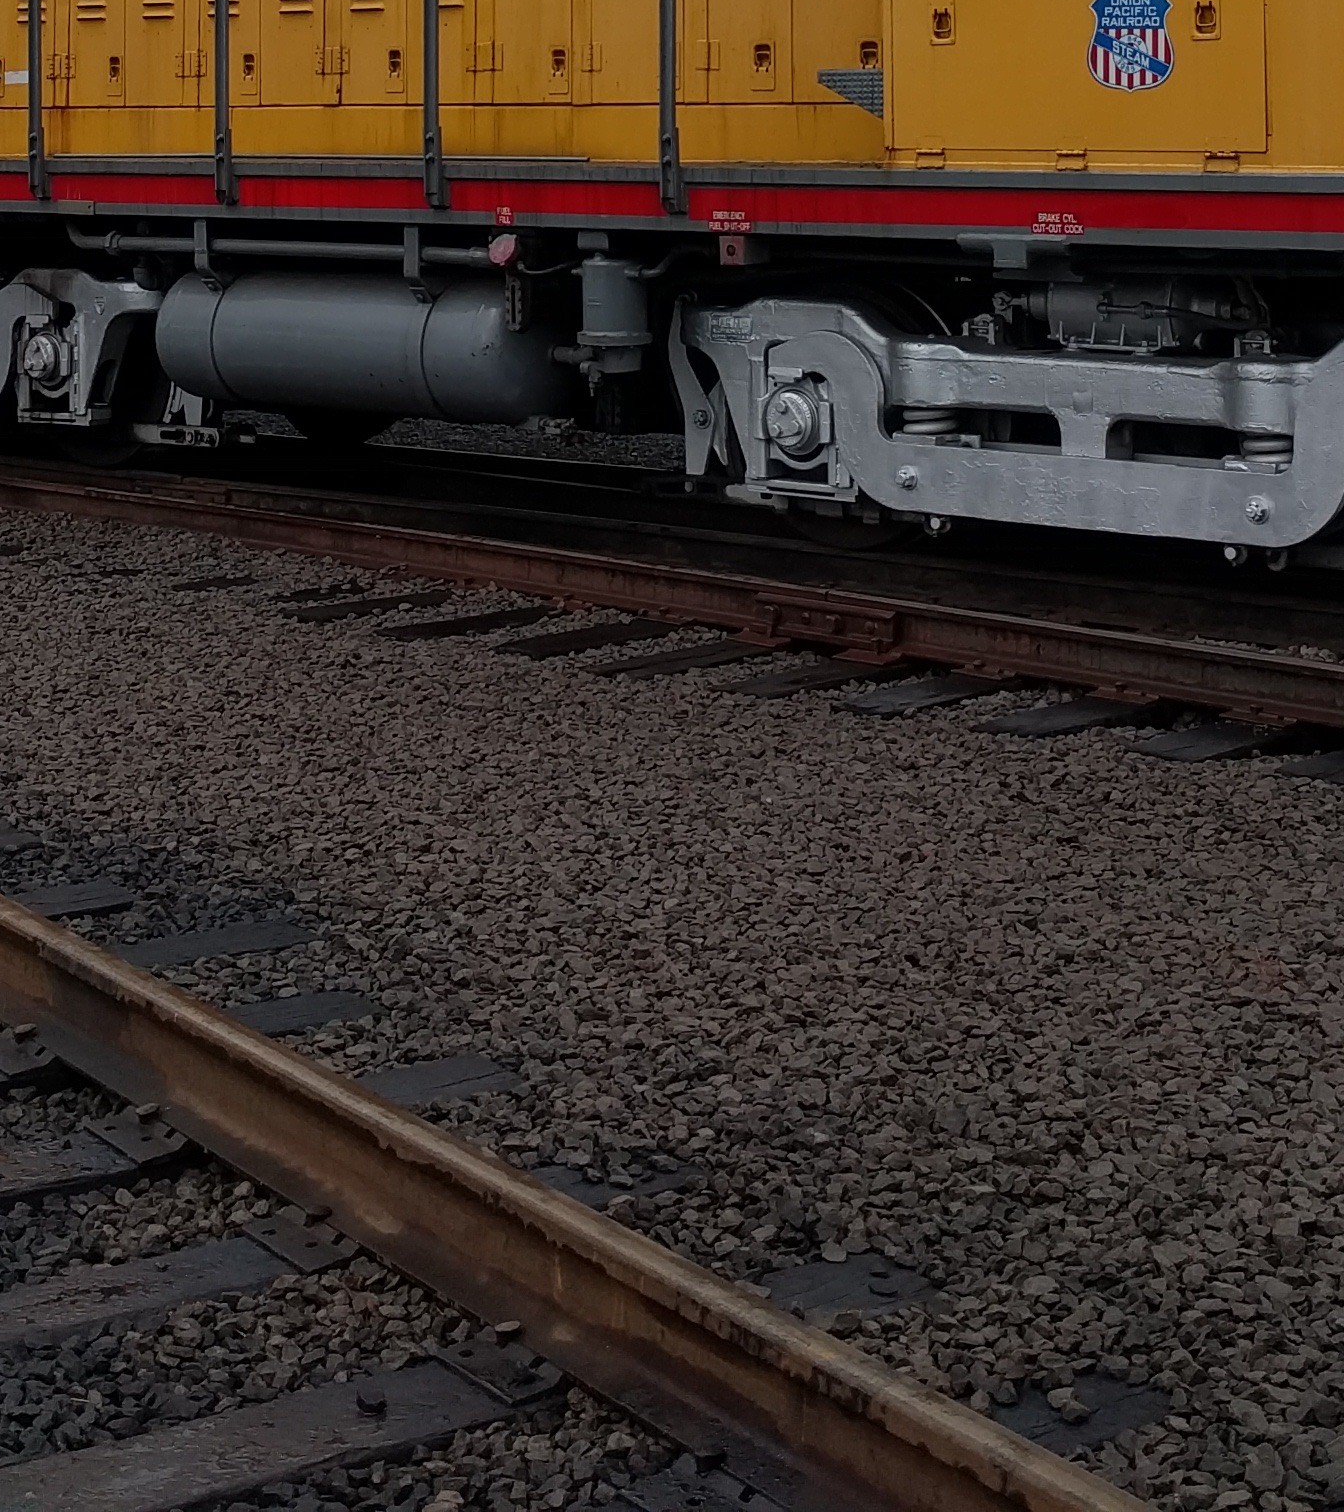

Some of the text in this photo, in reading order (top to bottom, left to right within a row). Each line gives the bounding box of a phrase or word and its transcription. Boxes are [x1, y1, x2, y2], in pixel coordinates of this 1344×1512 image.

[1104, 6, 1157, 16] PACIFIC
[1101, 17, 1160, 27] RAILROAD
[1112, 40, 1150, 69] STEAM
[1038, 213, 1061, 223] BRAKE
[1032, 223, 1084, 234] CUT-OUT COCK
